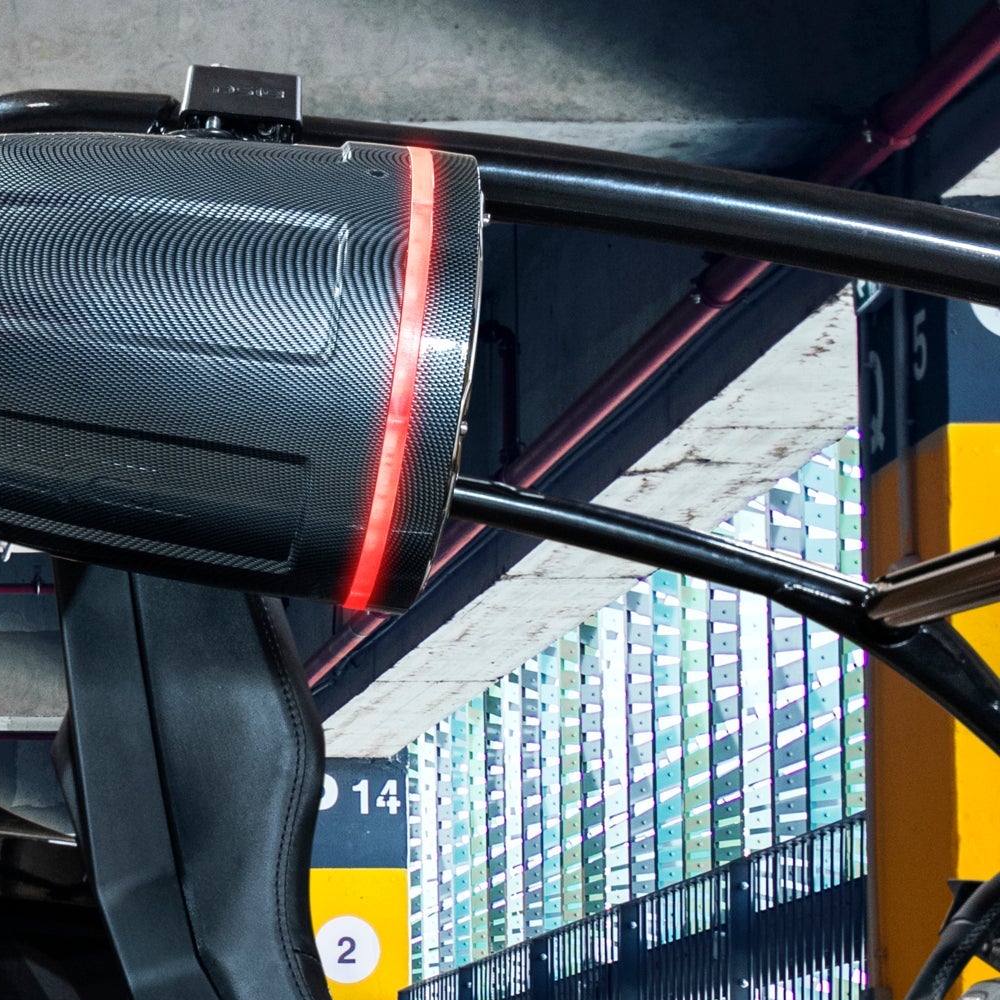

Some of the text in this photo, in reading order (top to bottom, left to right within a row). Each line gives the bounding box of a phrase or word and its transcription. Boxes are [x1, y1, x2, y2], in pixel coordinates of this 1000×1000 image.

[913, 308, 927, 382] 5
[352, 779, 401, 815] 14
[337, 936, 356, 964] 2
